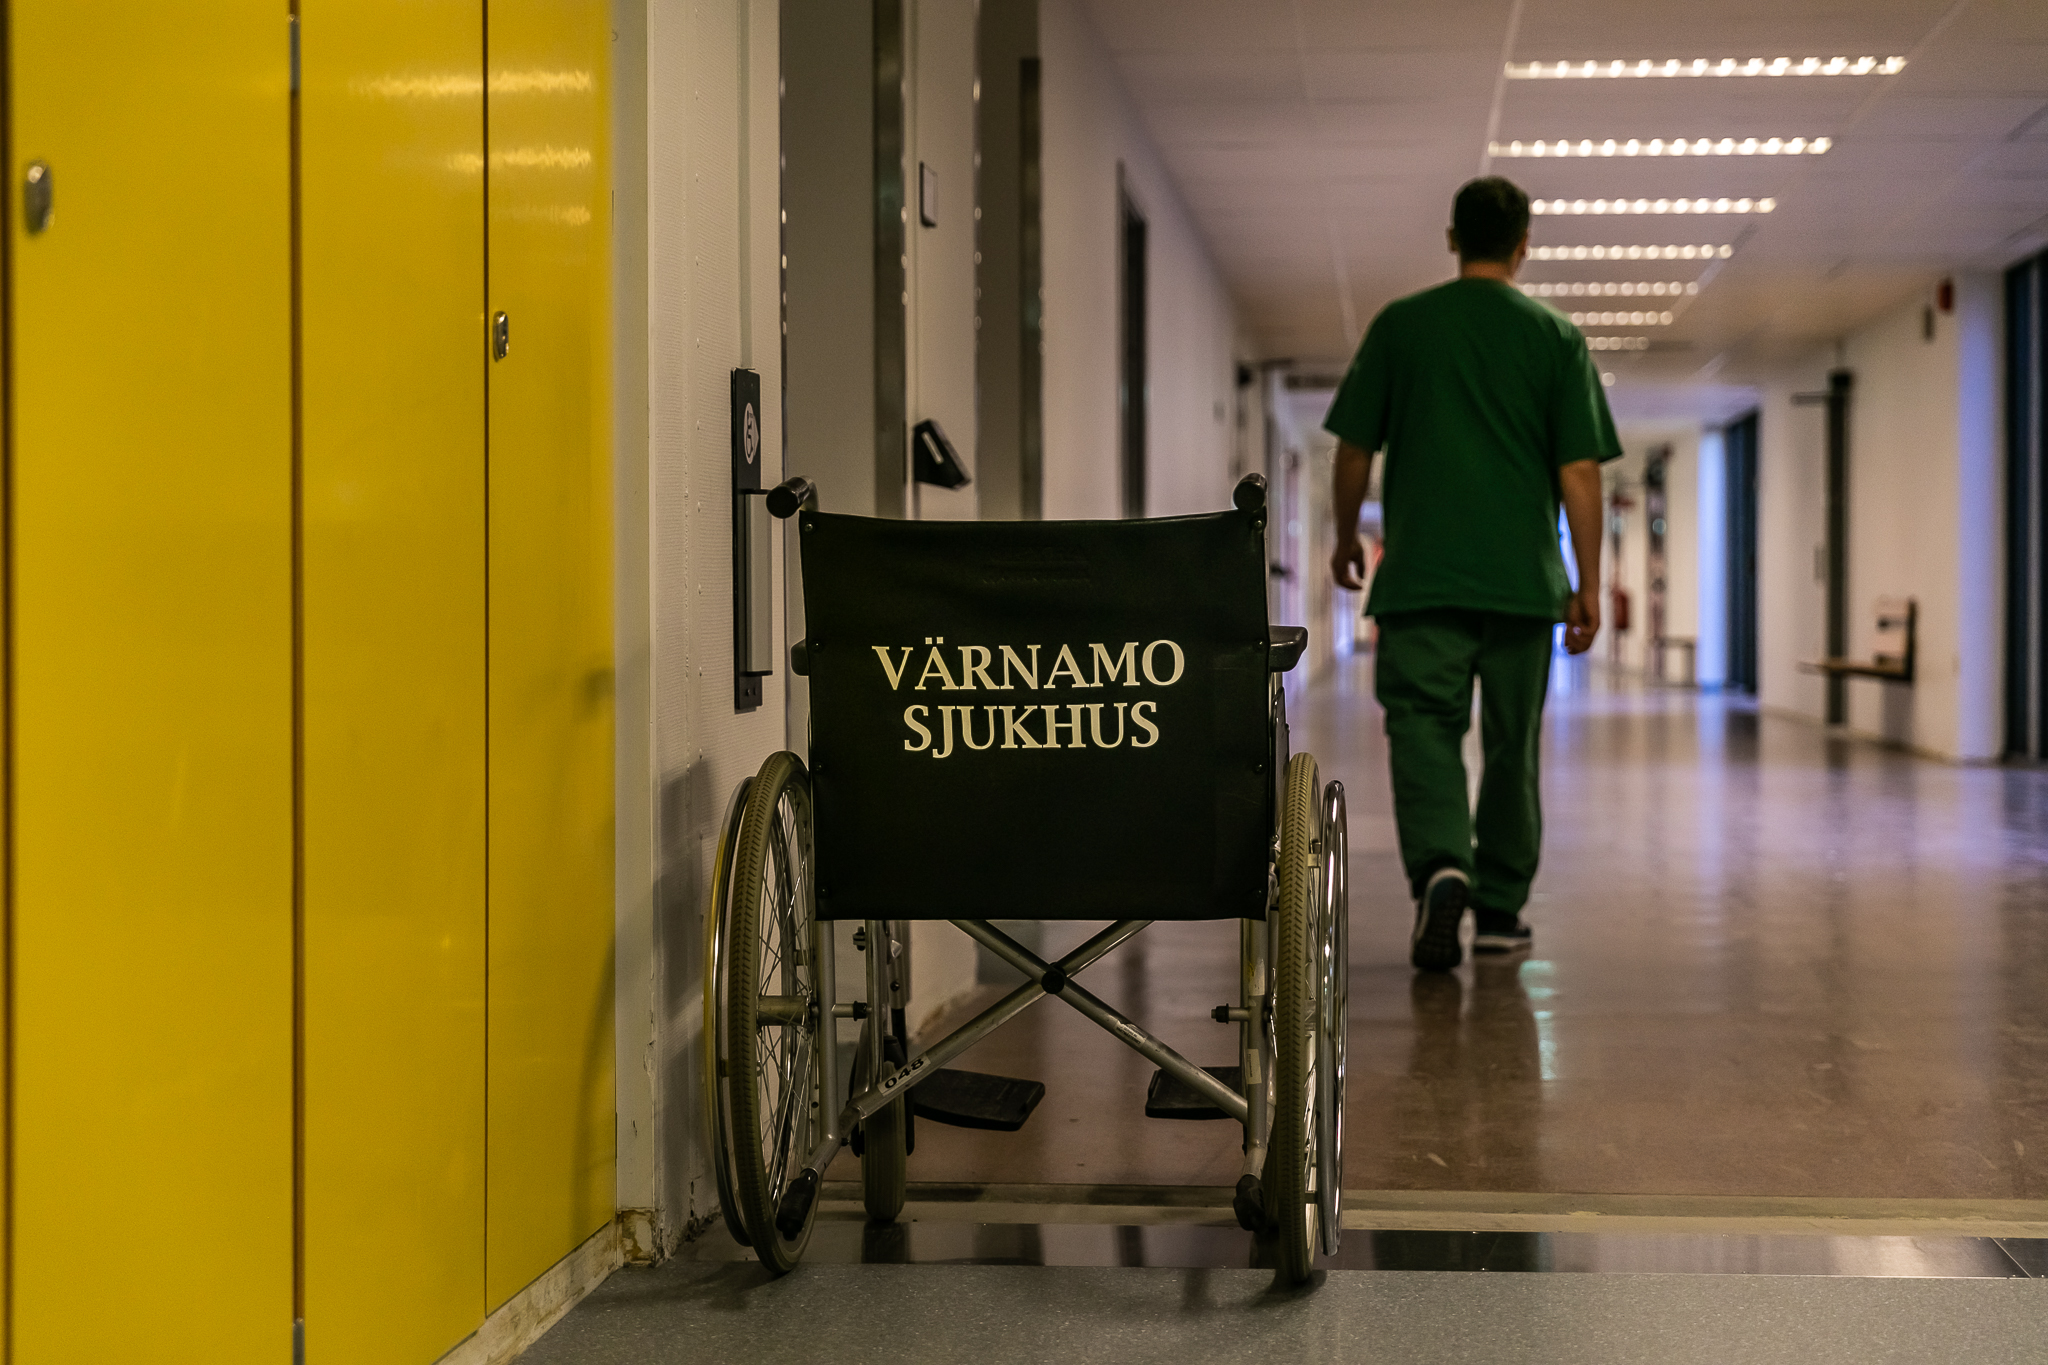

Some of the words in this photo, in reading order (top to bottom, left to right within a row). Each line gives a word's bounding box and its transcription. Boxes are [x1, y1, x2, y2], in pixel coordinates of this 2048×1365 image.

[871, 636, 1185, 691] VÄRNAMO
[903, 701, 1160, 758] SJUKHUS
[884, 1058, 924, 1089] 048
